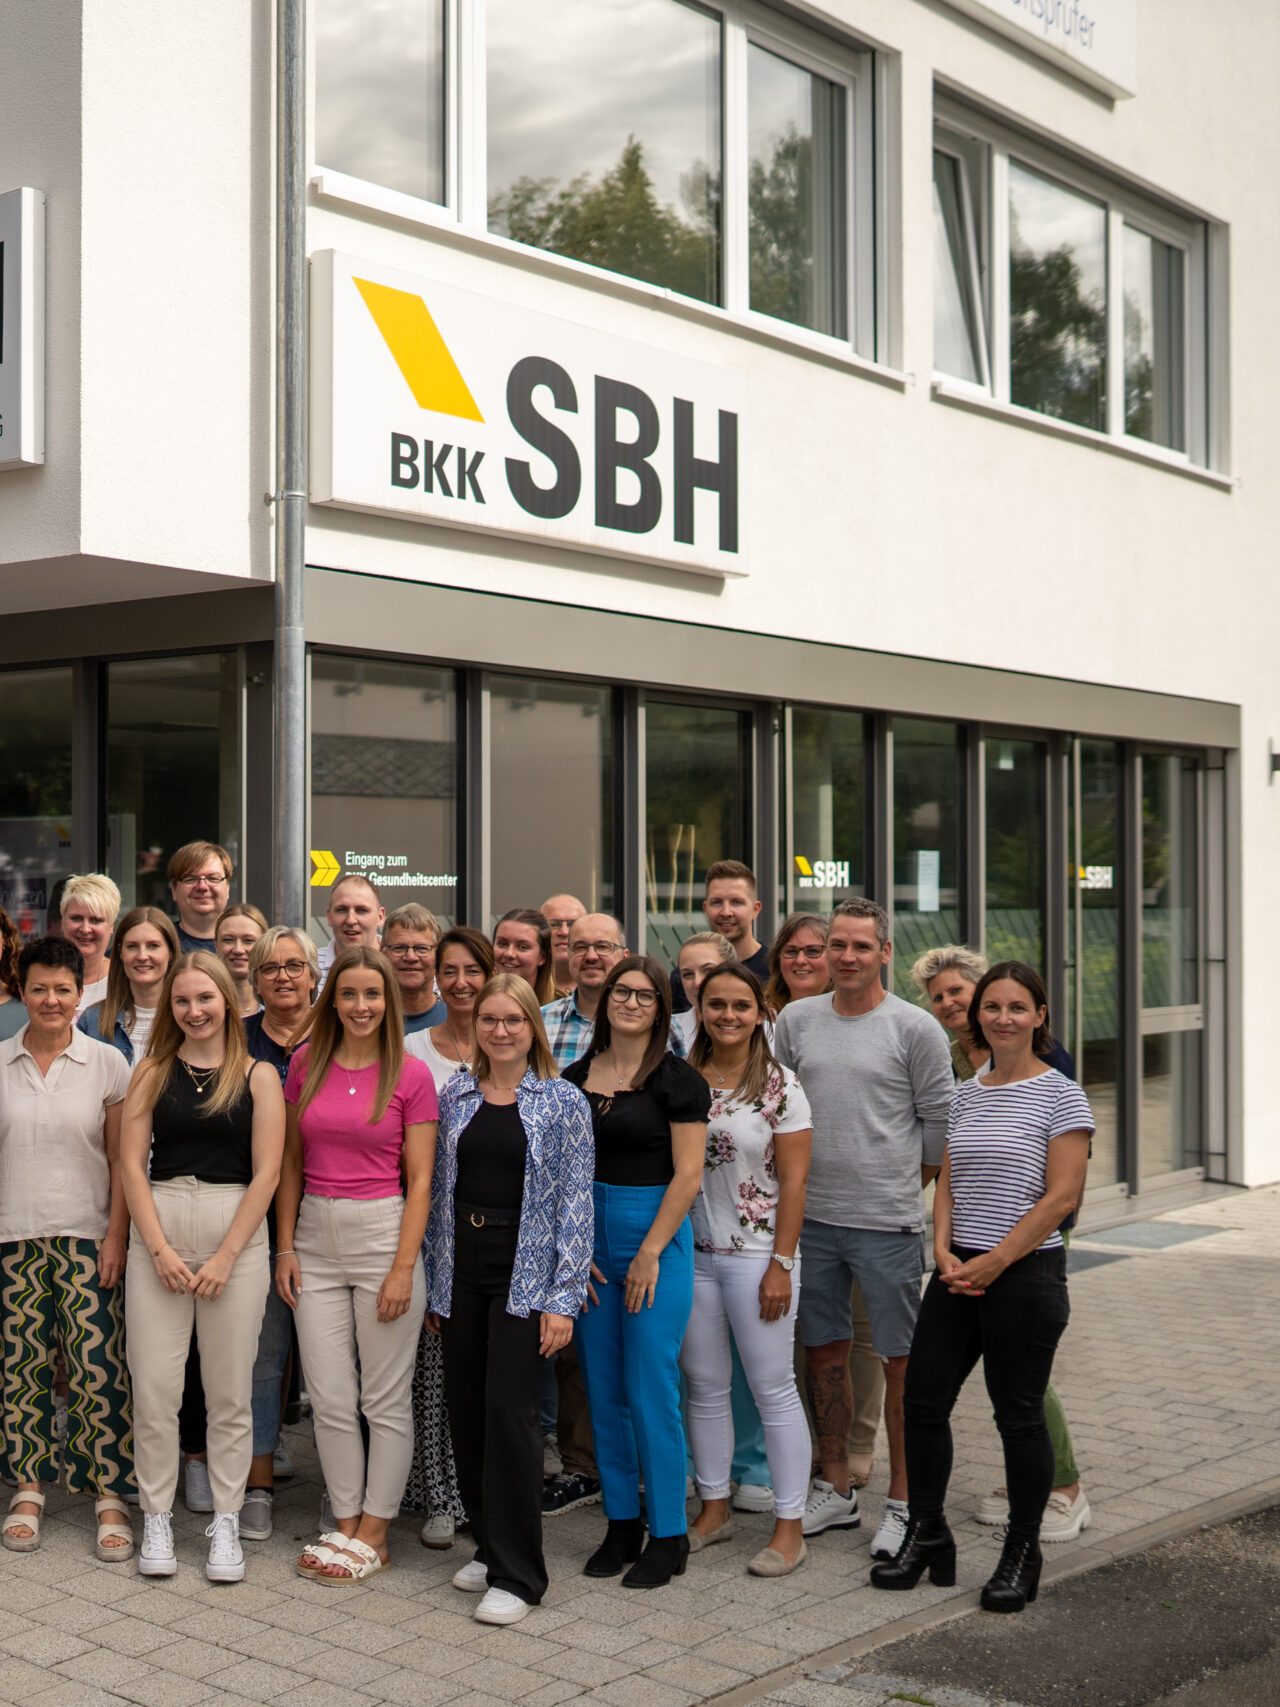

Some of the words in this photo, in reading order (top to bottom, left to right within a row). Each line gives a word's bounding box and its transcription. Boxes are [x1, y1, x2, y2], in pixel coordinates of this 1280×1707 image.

[390, 431, 487, 505] BKK
[504, 355, 739, 554] SBH
[345, 851, 385, 869] Eingang
[386, 855, 407, 867] zum
[369, 872, 458, 886] Gesundheitscenter
[813, 860, 850, 889] SBH
[1085, 865, 1113, 889] SBH
